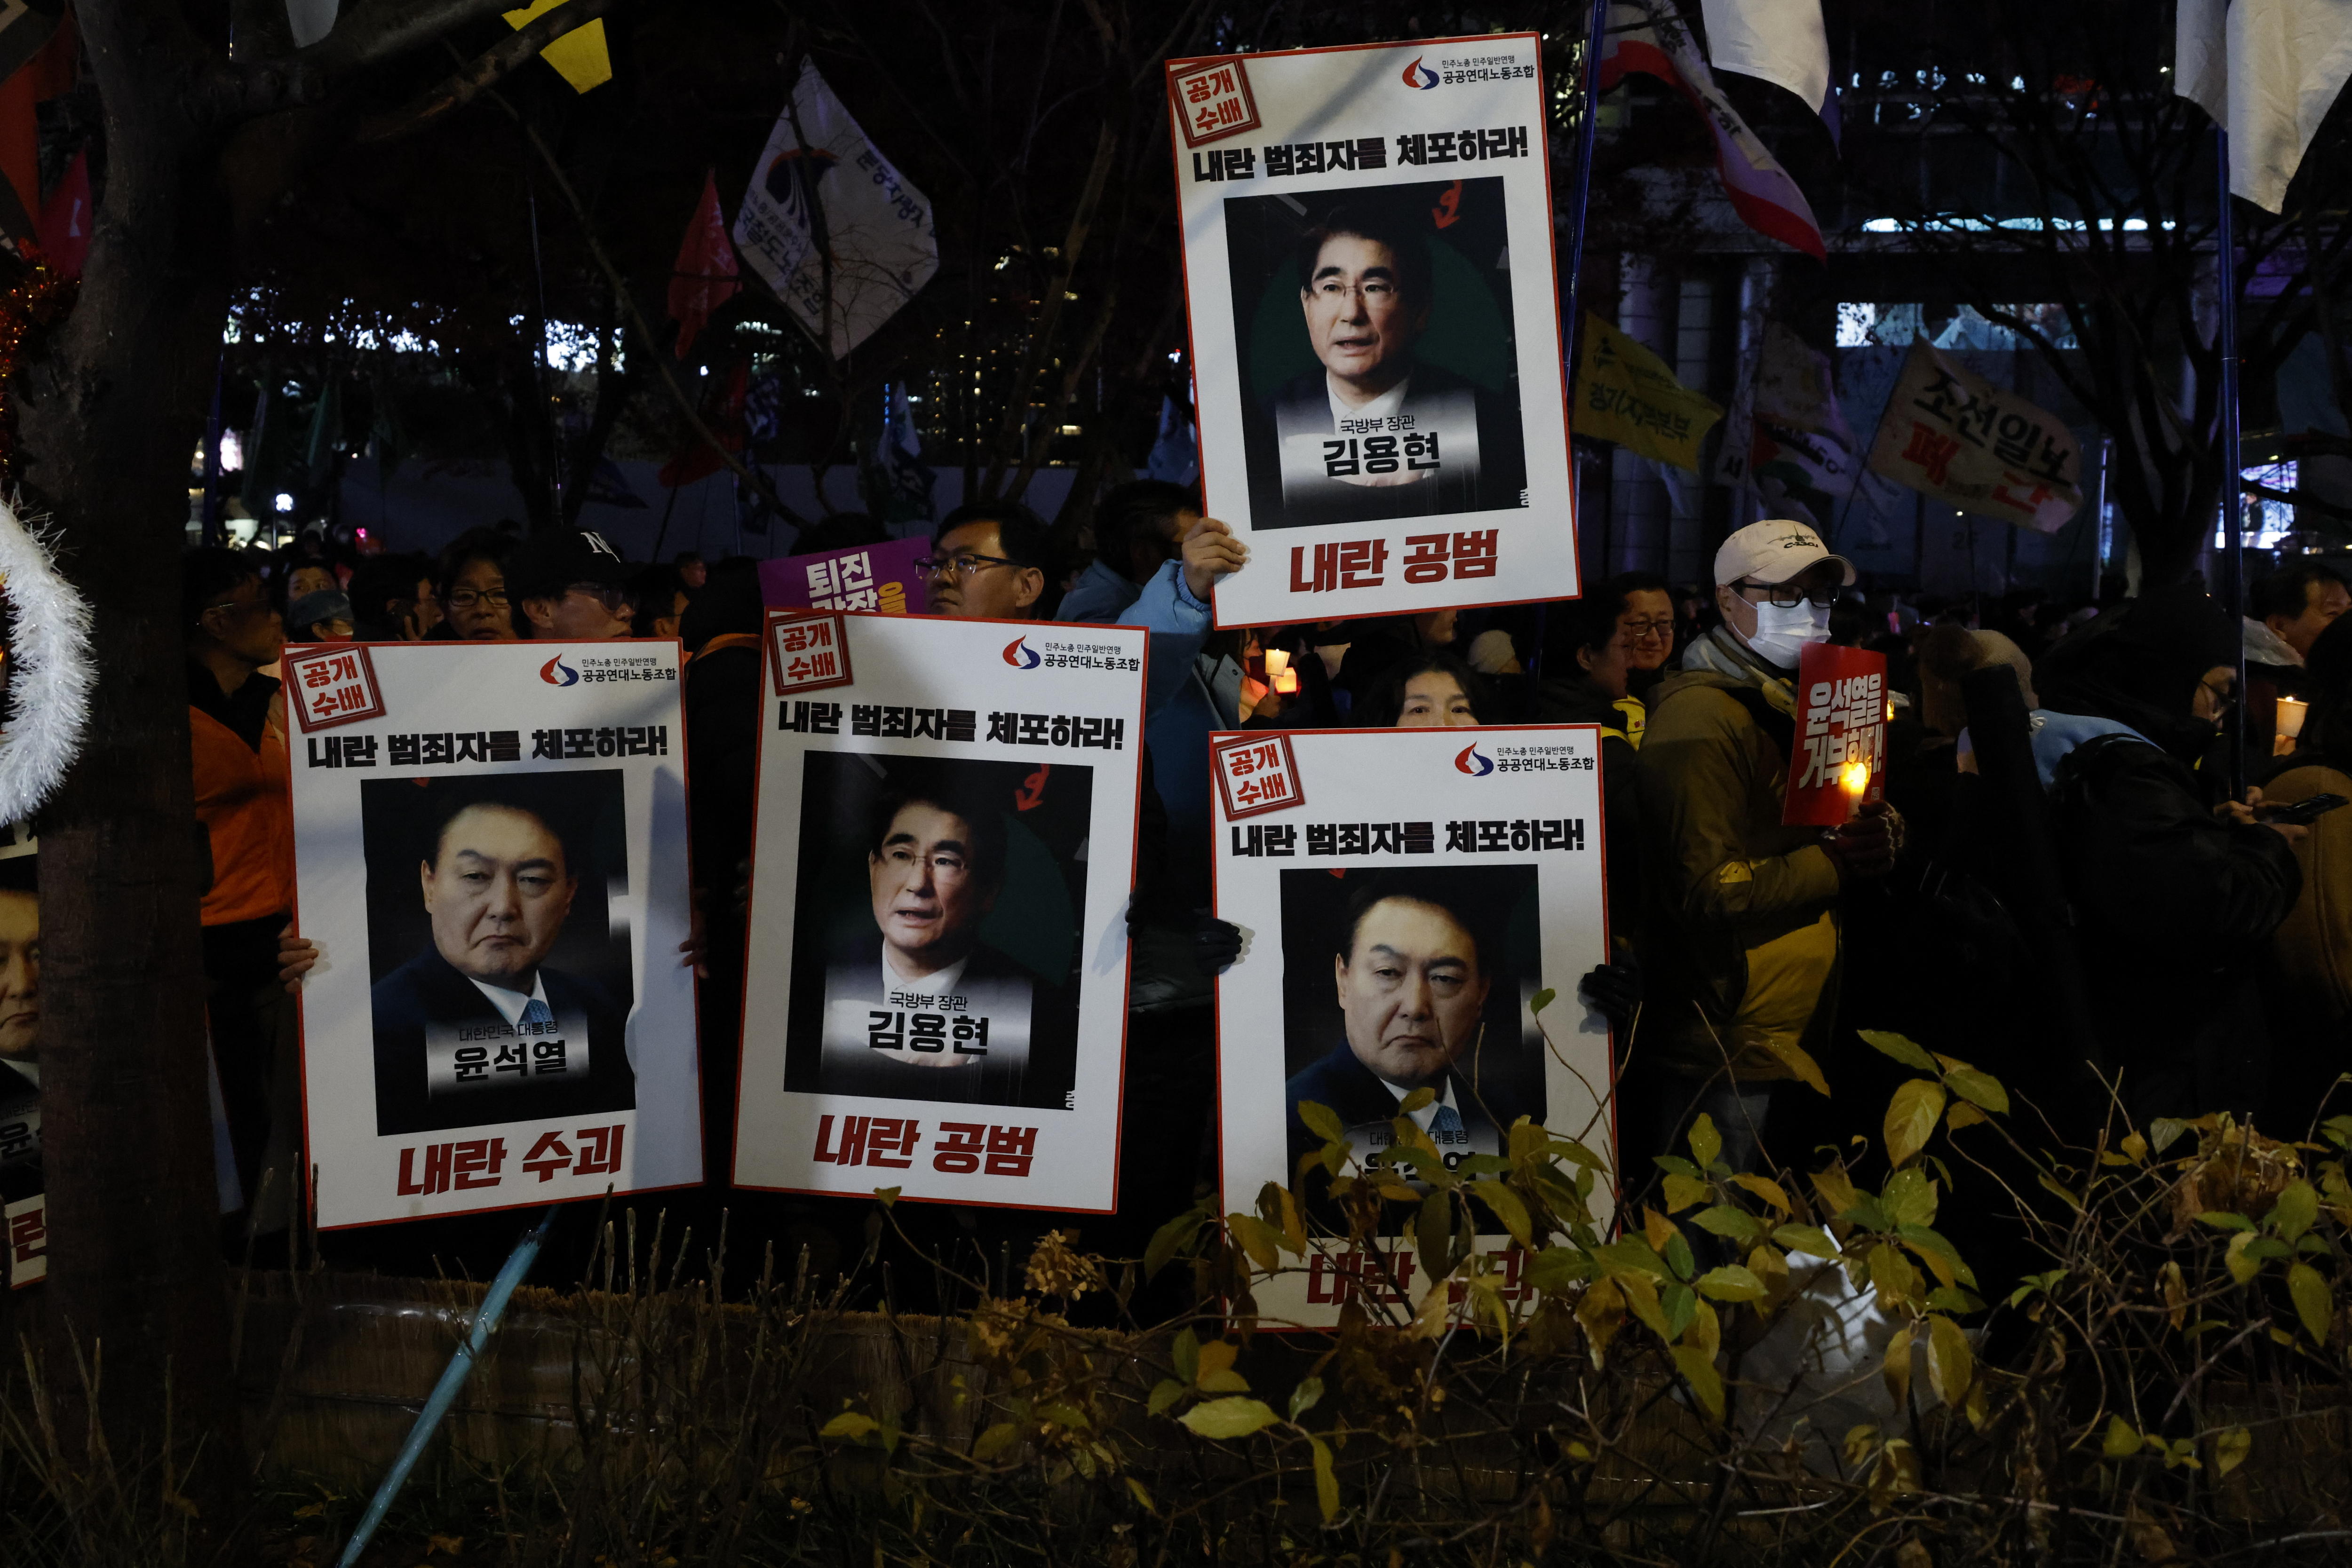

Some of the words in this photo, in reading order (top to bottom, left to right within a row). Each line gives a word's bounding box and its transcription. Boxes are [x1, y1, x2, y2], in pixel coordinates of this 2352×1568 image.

[1442, 58, 1470, 69] 민주노총
[1473, 55, 1515, 67] 민주일반연맹
[1443, 65, 1534, 84] 공공연대노동조합
[1186, 68, 1236, 103] 공개
[1195, 99, 1244, 131] 수배
[1193, 148, 1255, 182] 내란
[1263, 137, 1386, 177] 범죄자를
[1397, 126, 1529, 166] 체포하라!
[1341, 418, 1383, 434] 국방부
[1387, 415, 1415, 431] 장관
[1323, 431, 1441, 476] 김용현
[806, 551, 873, 598] 퇴진
[1290, 539, 1389, 594] 내란
[1403, 529, 1499, 584] 공범
[783, 623, 832, 652] 공개
[1045, 642, 1074, 652] 민주노총
[1076, 643, 1121, 655] 민주일반연맹
[302, 655, 358, 688] 공개
[582, 658, 612, 667] 민주노총
[613, 657, 657, 667] 민주일반연맹
[582, 667, 676, 682] 공공연대노동조합
[787, 652, 836, 681] 수배
[1044, 654, 1140, 672] 공공연대노동조합
[311, 684, 366, 716] 수배
[1806, 673, 1881, 736] 윤석열을
[779, 701, 842, 734] 내란
[851, 705, 976, 742] 범죄자를
[986, 711, 1124, 751] 체포하라!
[308, 736, 378, 769] 내란
[388, 730, 521, 766] 범죄자를
[531, 726, 668, 760] 체포하라!
[1229, 743, 1280, 776] 공개
[1497, 746, 1526, 756] 민주노총
[1529, 745, 1574, 755] 민주일반연맹
[1497, 757, 1594, 772] 공공연대노동조합
[1237, 773, 1287, 805] 수배
[1232, 824, 1297, 857] 내란
[1306, 821, 1434, 856] 범죄자를
[1445, 818, 1584, 853] 체포하라!
[890, 991, 934, 1009] 국방부
[938, 995, 968, 1012] 장관
[459, 1023, 514, 1041] 대한민국
[517, 1021, 558, 1037] 대통령
[868, 1011, 989, 1055] 김용현
[454, 1040, 567, 1082] 윤석열
[397, 1138, 508, 1196] 내란
[522, 1125, 626, 1183] 수괴
[813, 1114, 921, 1169] 내란
[932, 1121, 1039, 1177] 공범
[1307, 1251, 1416, 1306] 내란
